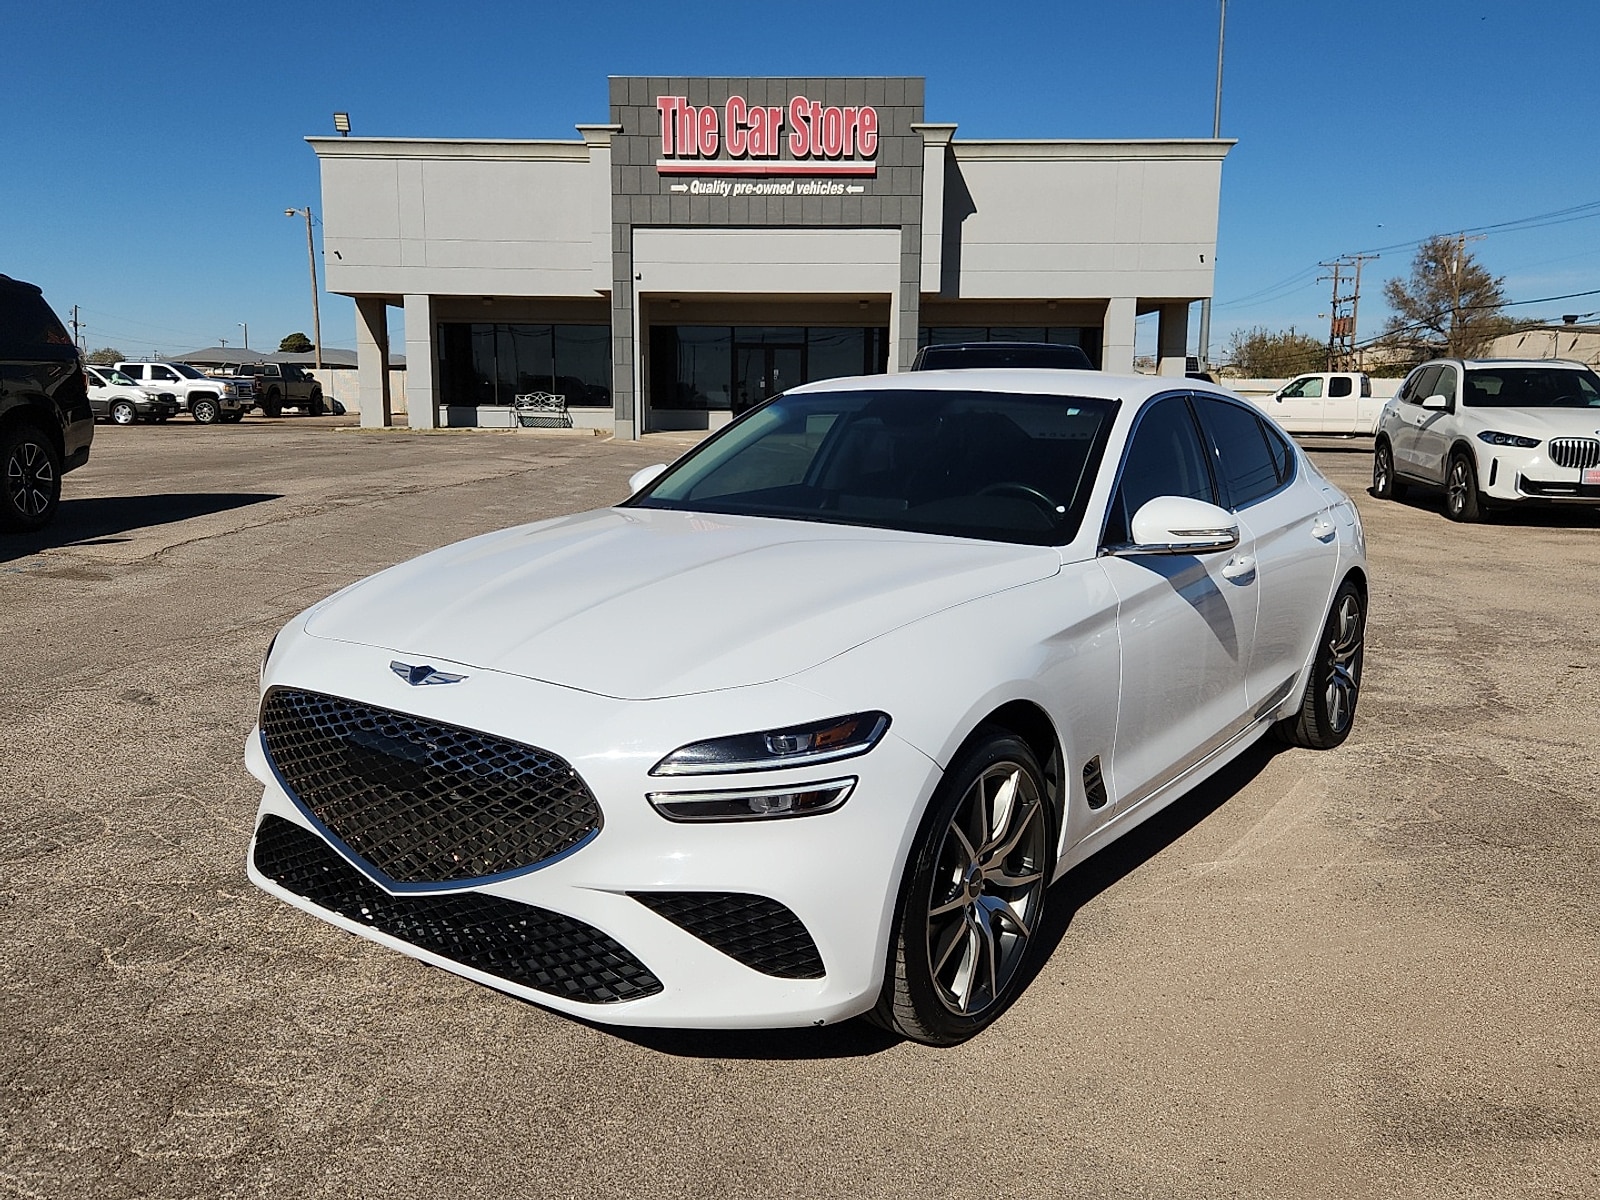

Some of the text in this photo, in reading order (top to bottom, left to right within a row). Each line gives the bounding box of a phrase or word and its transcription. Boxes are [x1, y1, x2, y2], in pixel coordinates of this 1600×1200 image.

[657, 95, 877, 157] The Car Store
[690, 180, 845, 197] Quality pre-owned vehicles
